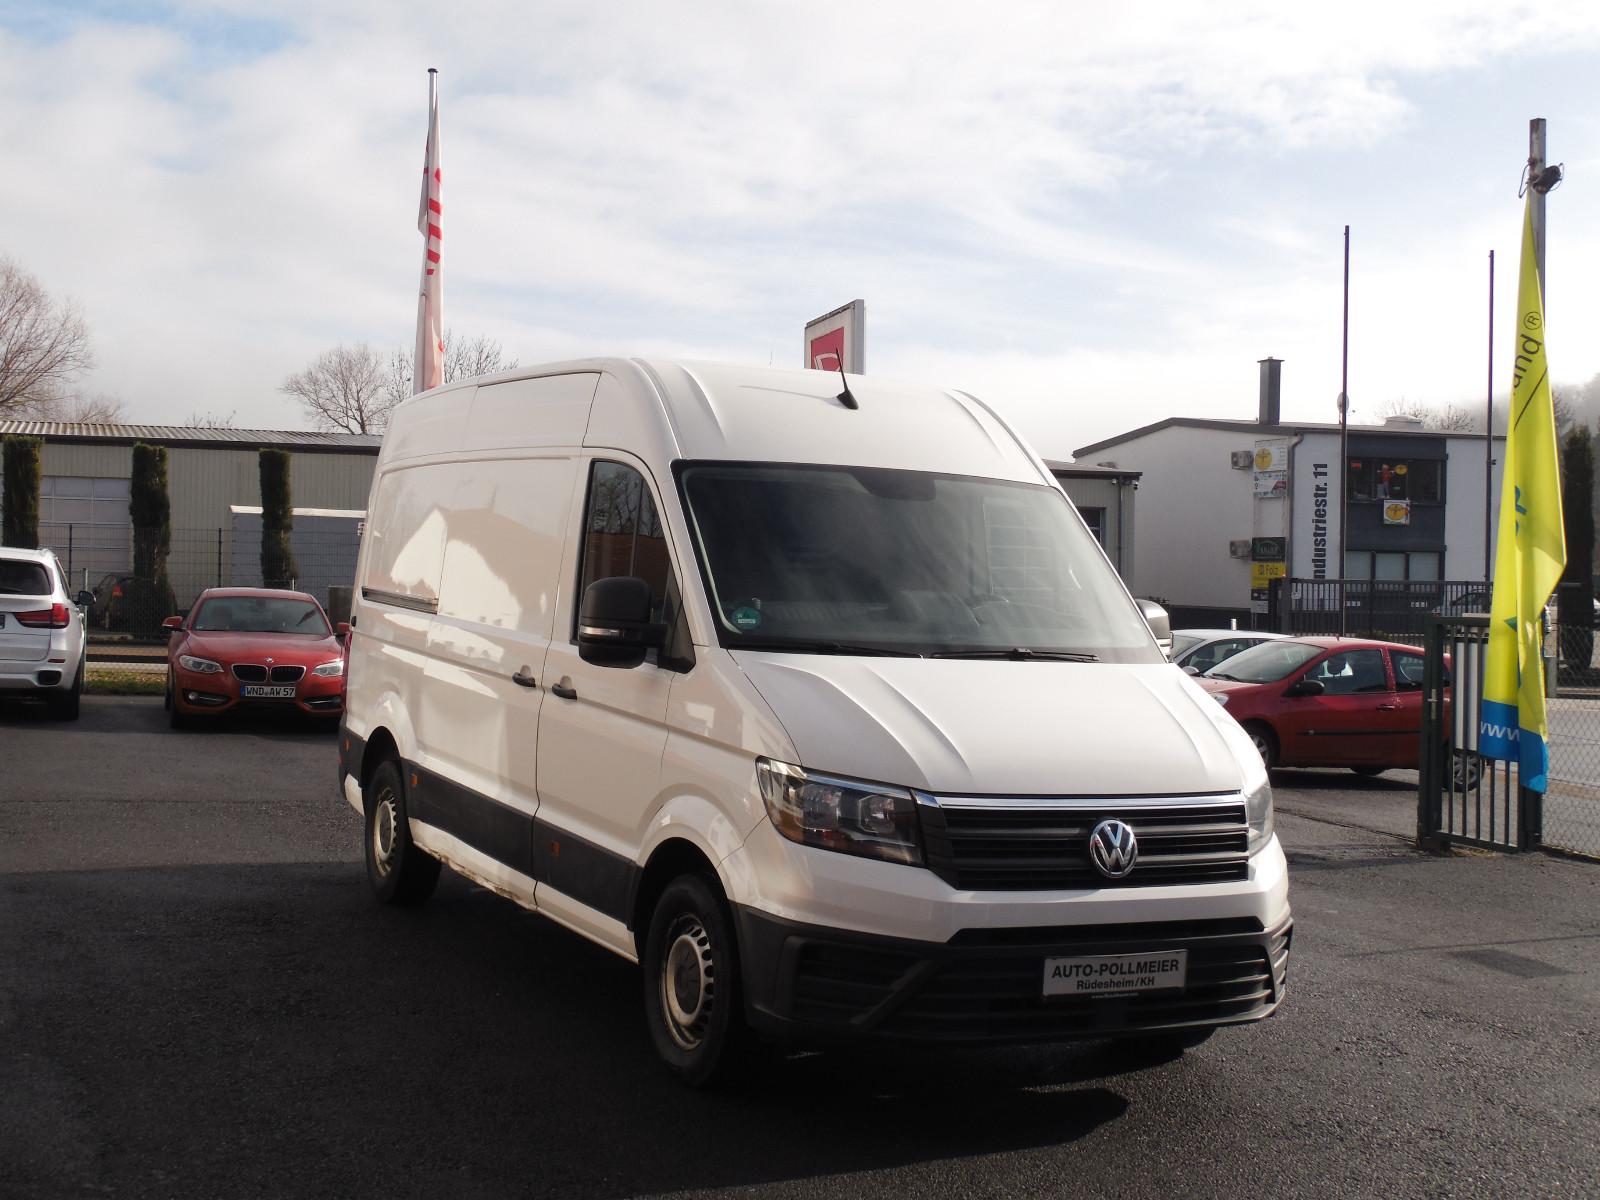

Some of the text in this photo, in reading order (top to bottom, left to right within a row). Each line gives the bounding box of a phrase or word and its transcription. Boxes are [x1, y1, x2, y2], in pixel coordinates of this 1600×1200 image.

[1311, 463, 1328, 579] ndustriestr. 11
[283, 687, 295, 697] 57
[1051, 959, 1179, 979] AUTO-POLLMEIER
[1076, 976, 1155, 991] Rüdesheim/KH
